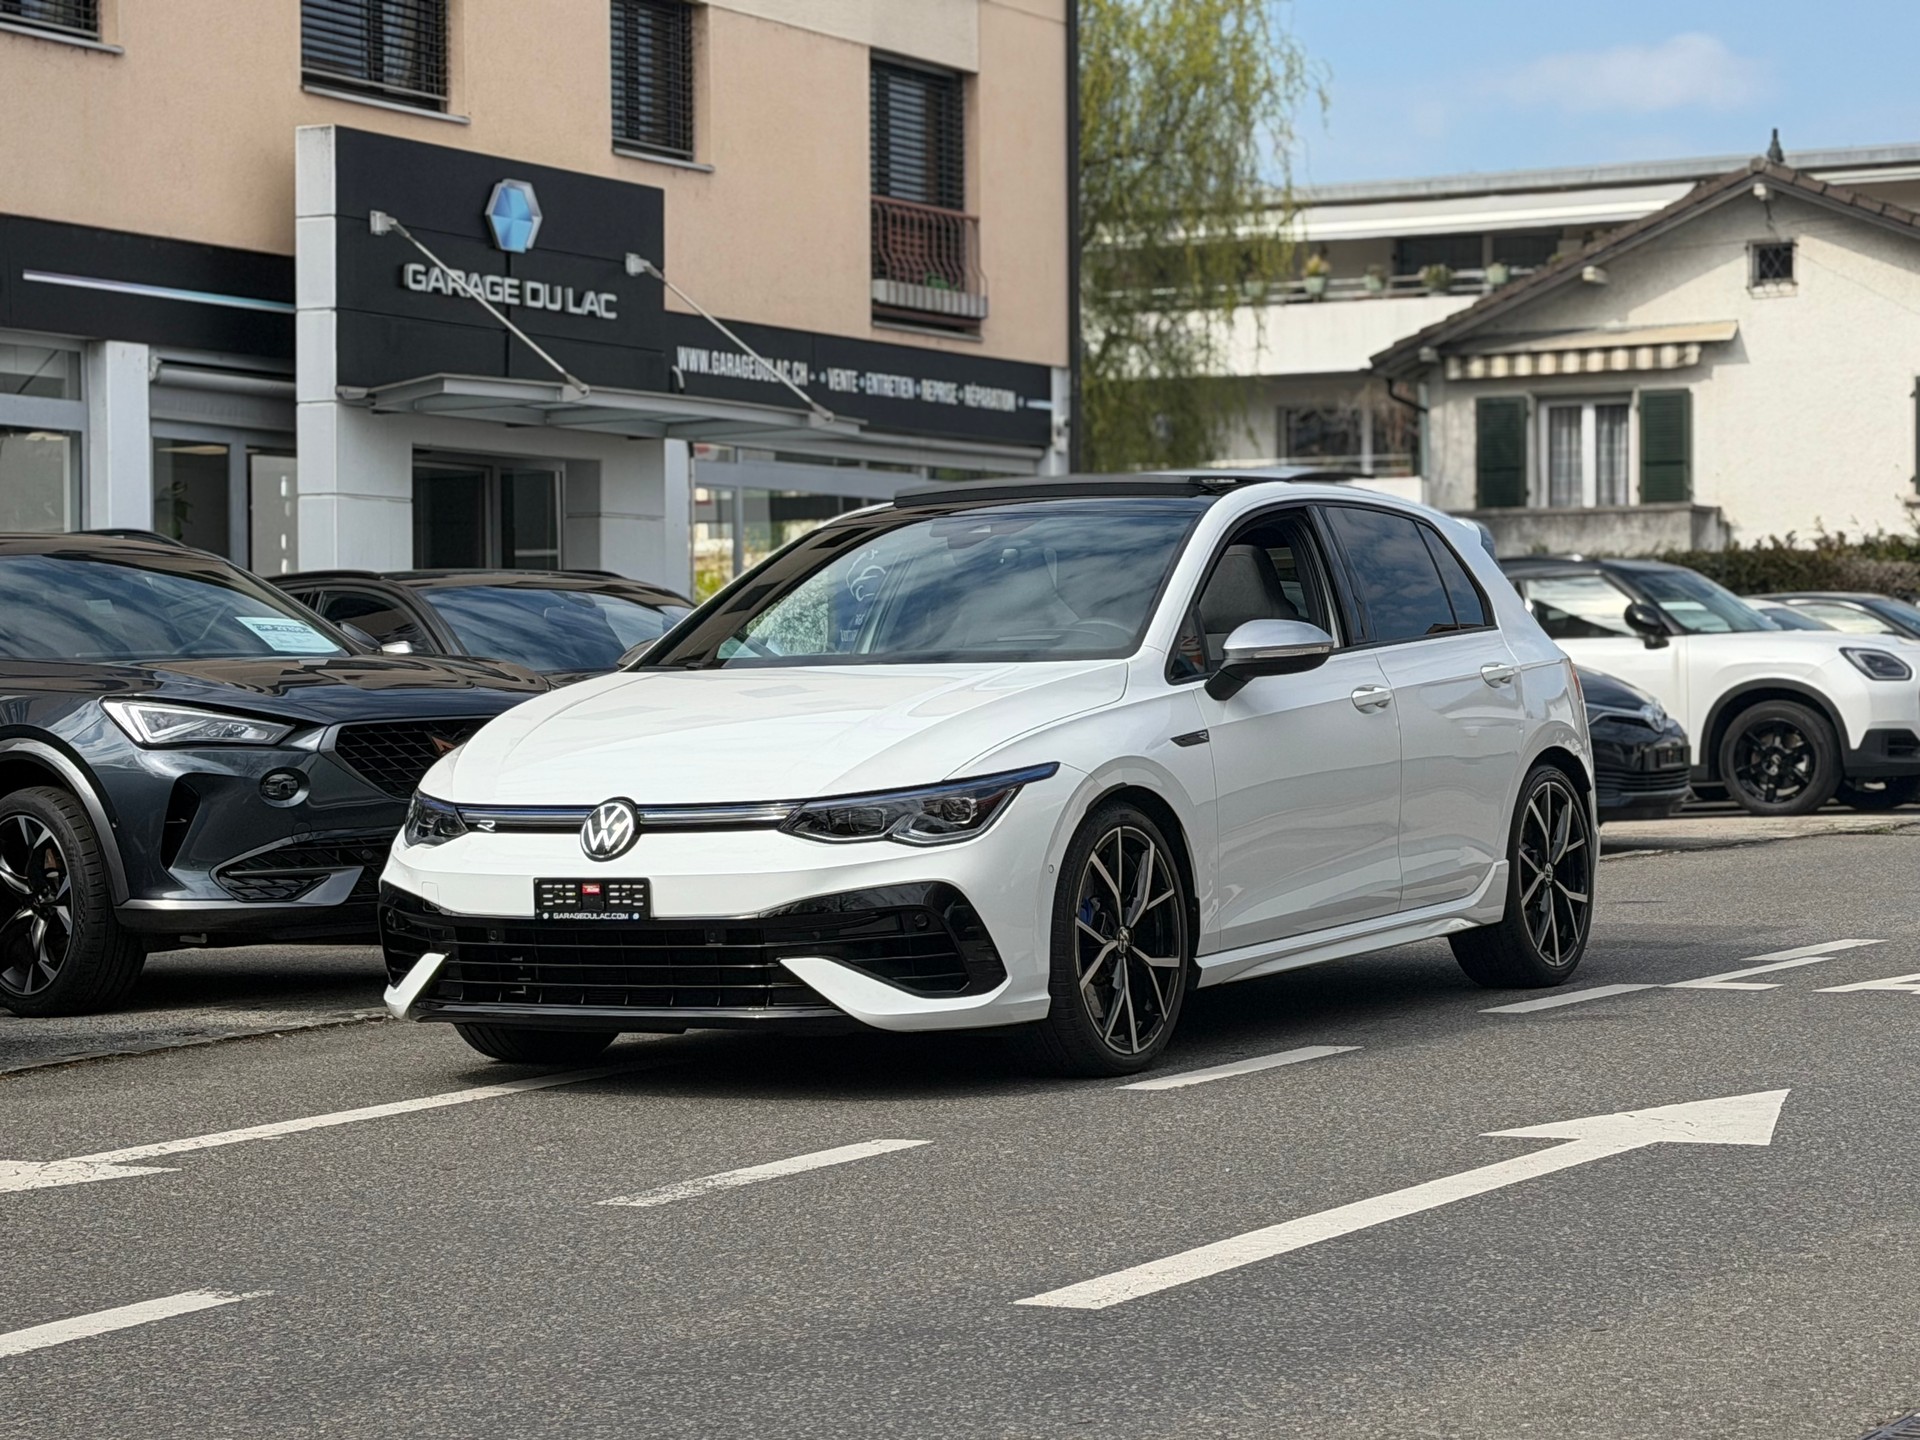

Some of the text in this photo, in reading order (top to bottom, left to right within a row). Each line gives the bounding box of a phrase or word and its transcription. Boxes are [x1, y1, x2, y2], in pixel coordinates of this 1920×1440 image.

[404, 263, 618, 319] GARAGE DU LAC
[676, 346, 809, 387] WWW.GARAGEDULAC.CH
[828, 367, 858, 393] VENTE
[865, 372, 915, 399] ENTRETIEN
[921, 379, 958, 405] REPRISE
[553, 912, 629, 920] GARAGEDULAC.COM
